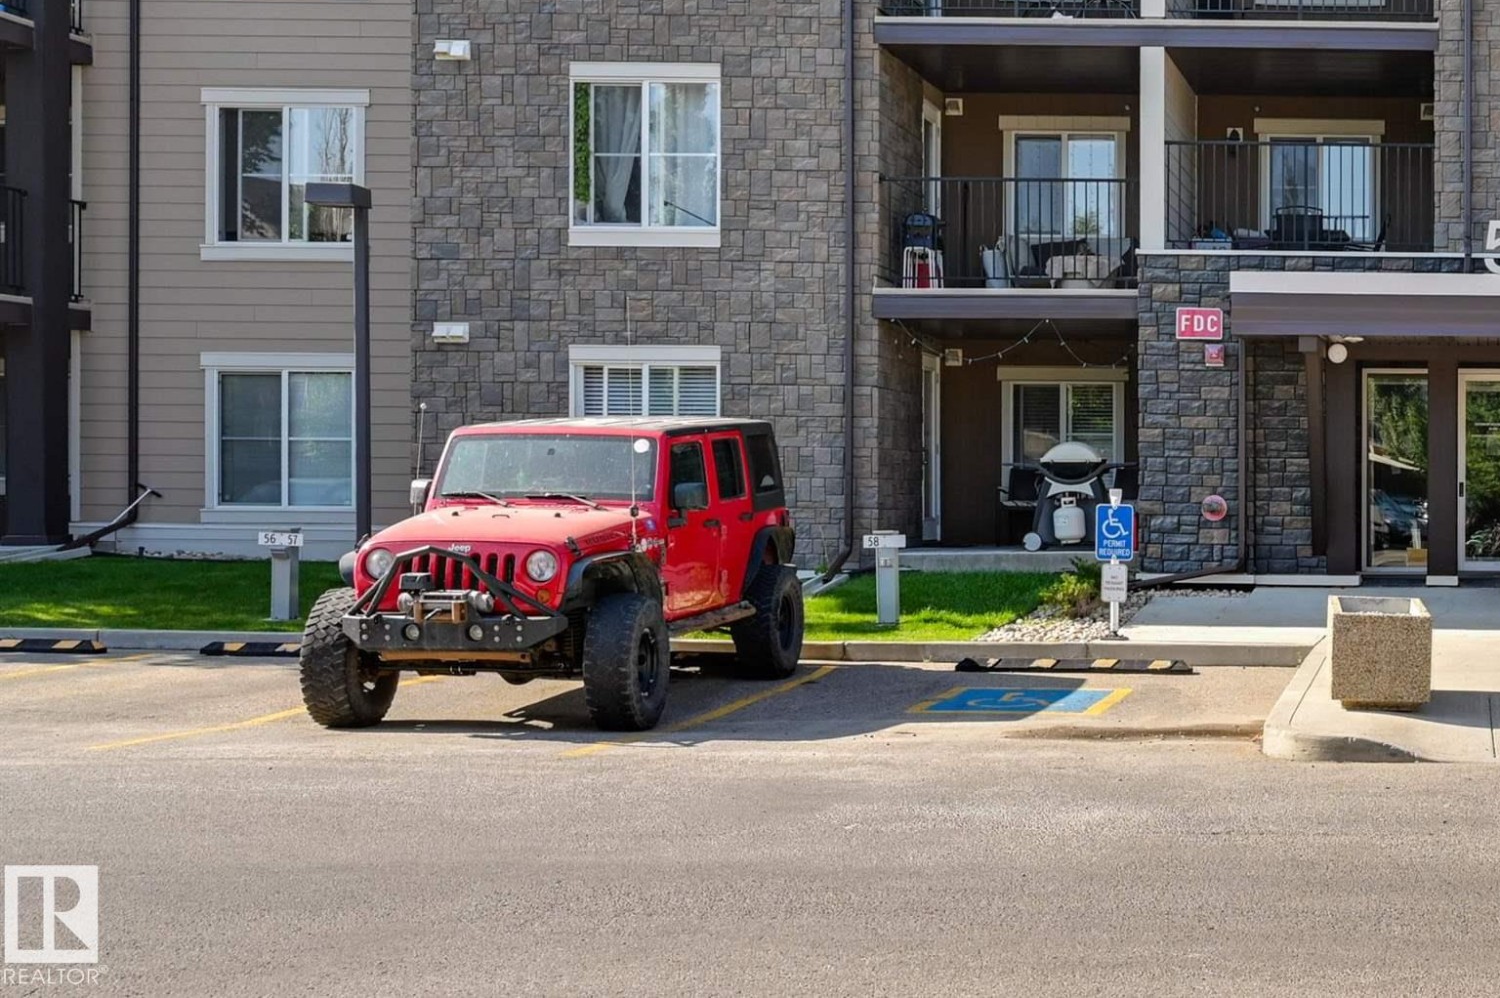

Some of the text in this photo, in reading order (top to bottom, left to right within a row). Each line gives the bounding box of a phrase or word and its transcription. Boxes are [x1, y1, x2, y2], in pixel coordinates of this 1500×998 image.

[1181, 314, 1218, 332] FDC
[264, 533, 298, 545] 56 57
[868, 536, 880, 547] 58
[1103, 540, 1126, 548] PERMIT
[447, 543, 471, 553] Jeep
[1099, 548, 1131, 556] REQUIRED
